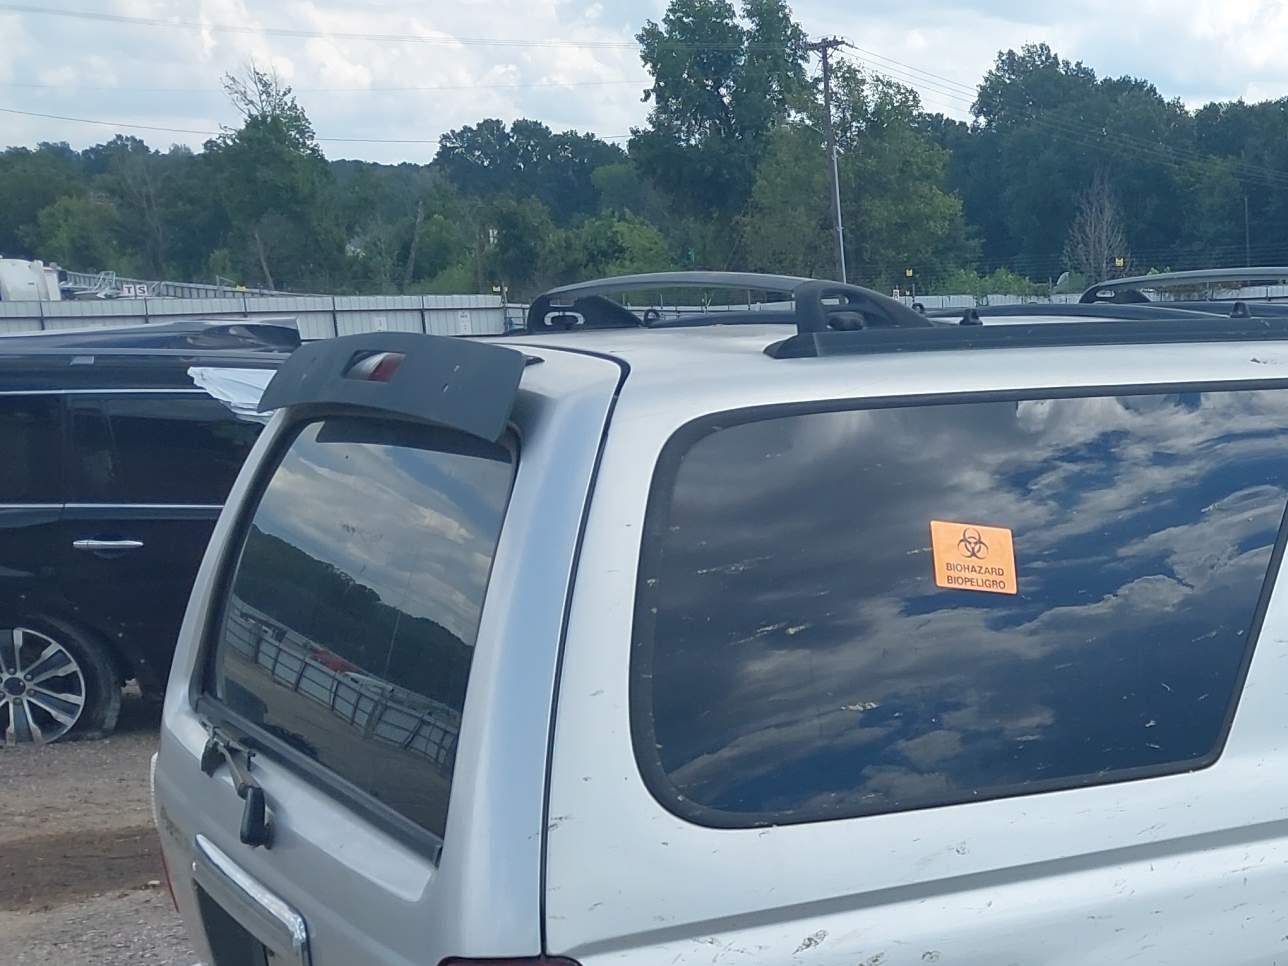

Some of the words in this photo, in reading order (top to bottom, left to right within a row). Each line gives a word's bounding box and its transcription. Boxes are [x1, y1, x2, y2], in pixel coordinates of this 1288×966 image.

[125, 286, 132, 295] T
[138, 286, 146, 295] S
[945, 562, 1005, 577] BIOHAZARD
[946, 576, 1006, 590] BIOPELIGRO
